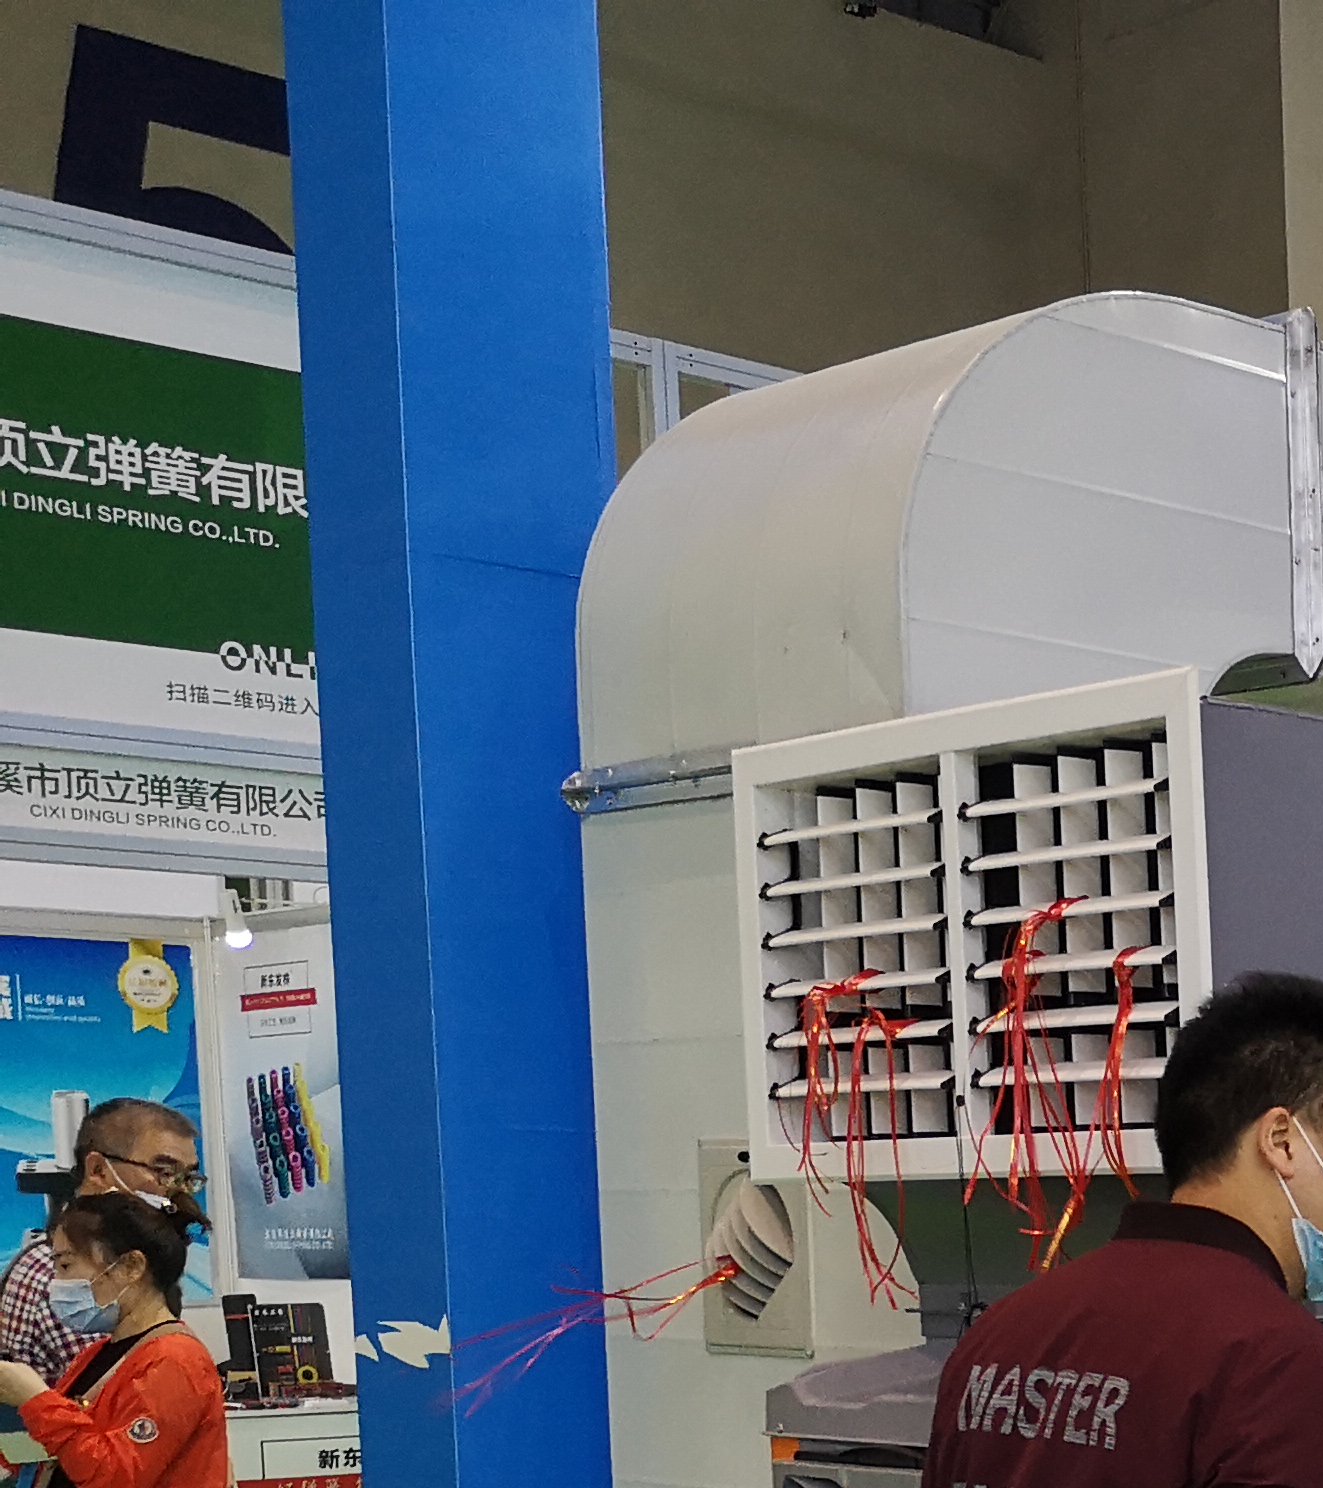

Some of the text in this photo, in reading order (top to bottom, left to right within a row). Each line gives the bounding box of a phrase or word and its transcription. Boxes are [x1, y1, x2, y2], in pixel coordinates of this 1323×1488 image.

[13, 491, 91, 520] DINGLI
[97, 504, 183, 534] SPRING
[188, 519, 280, 549] CO.,LTD.
[166, 680, 320, 717] 扫描二维码进入
[30, 804, 66, 820] CIXI
[71, 807, 130, 825] DINGLI
[135, 813, 201, 831] SPRING
[318, 1447, 361, 1469] 新东
